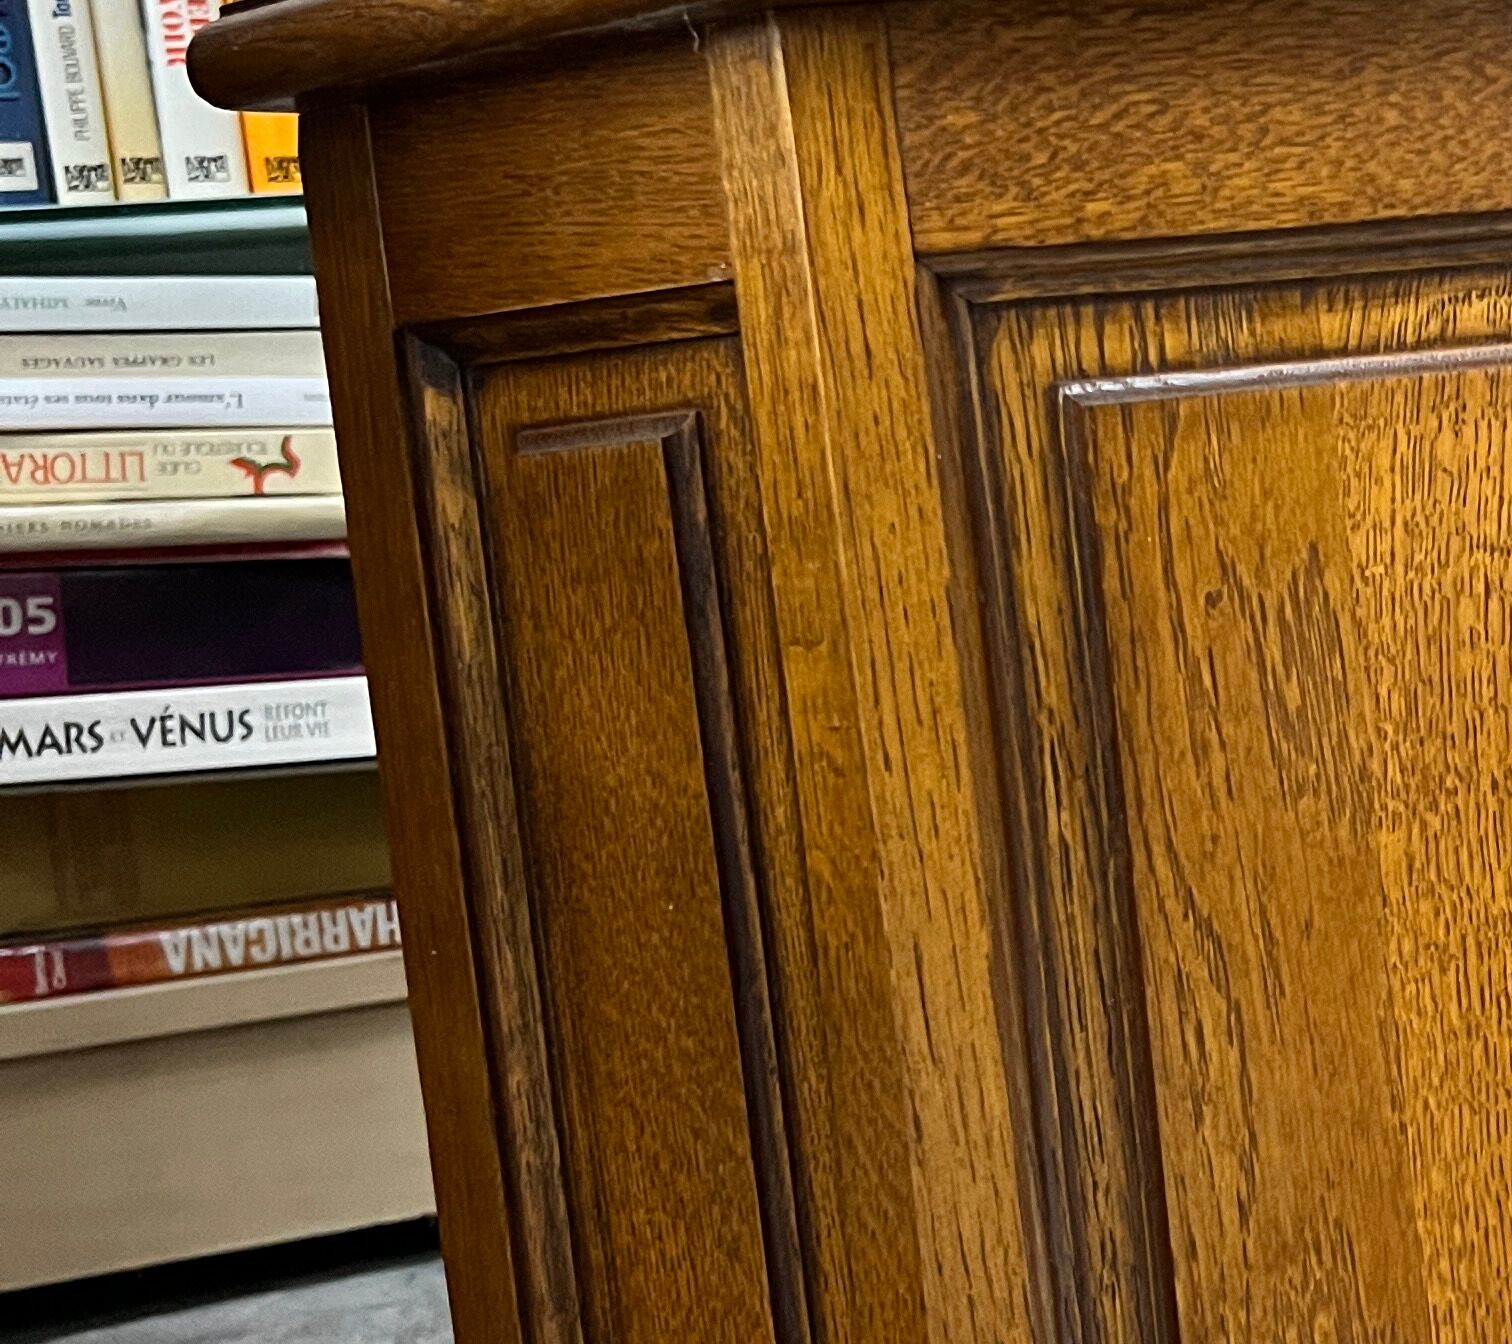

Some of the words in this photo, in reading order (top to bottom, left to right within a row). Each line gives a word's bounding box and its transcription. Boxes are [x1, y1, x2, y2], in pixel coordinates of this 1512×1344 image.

[59, 24, 84, 84] BOUVARD
[66, 86, 91, 142] PHILIPPE
[22, 356, 105, 369] SAUVAGES
[0, 719, 104, 760] MARS
[129, 704, 254, 749] VÉNUS
[159, 901, 403, 975] HARRICANA
